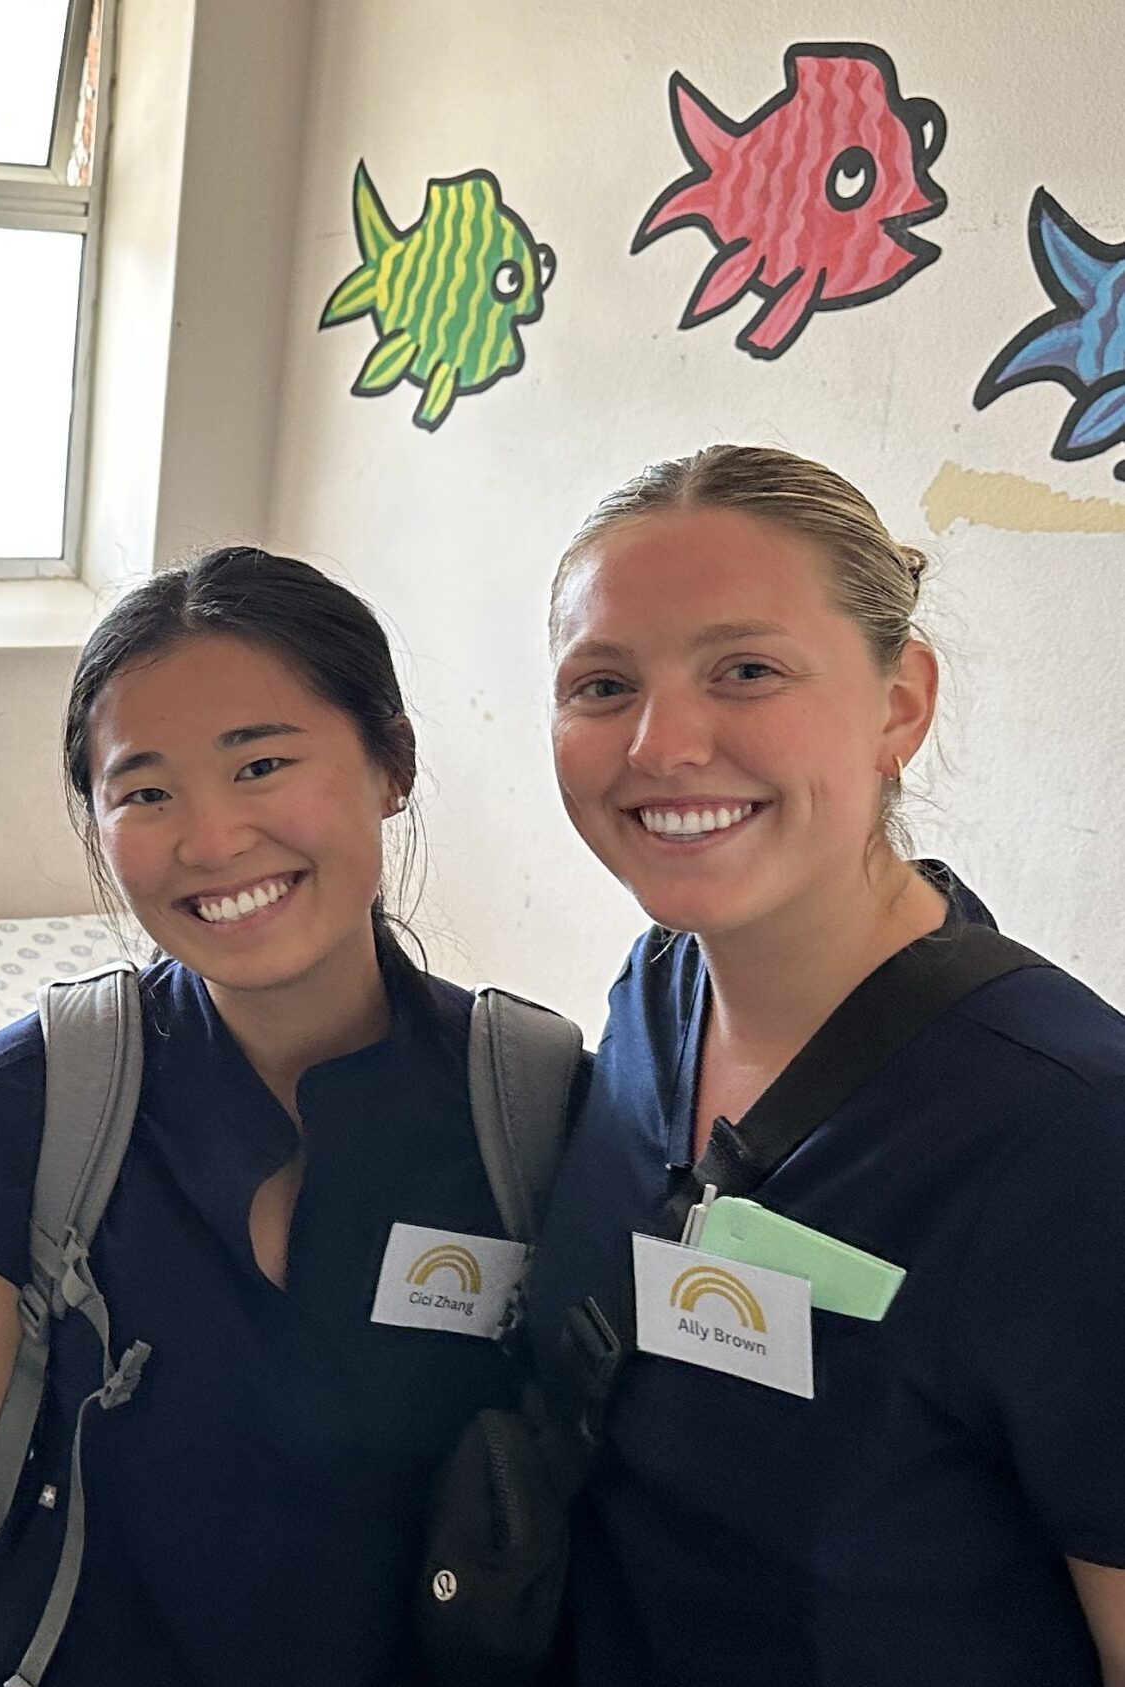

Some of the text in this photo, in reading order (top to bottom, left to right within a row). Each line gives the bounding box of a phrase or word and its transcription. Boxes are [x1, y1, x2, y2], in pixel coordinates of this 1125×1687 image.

[409, 1291, 475, 1317] Cici Zhang
[677, 1318, 767, 1356] Ally Brown
